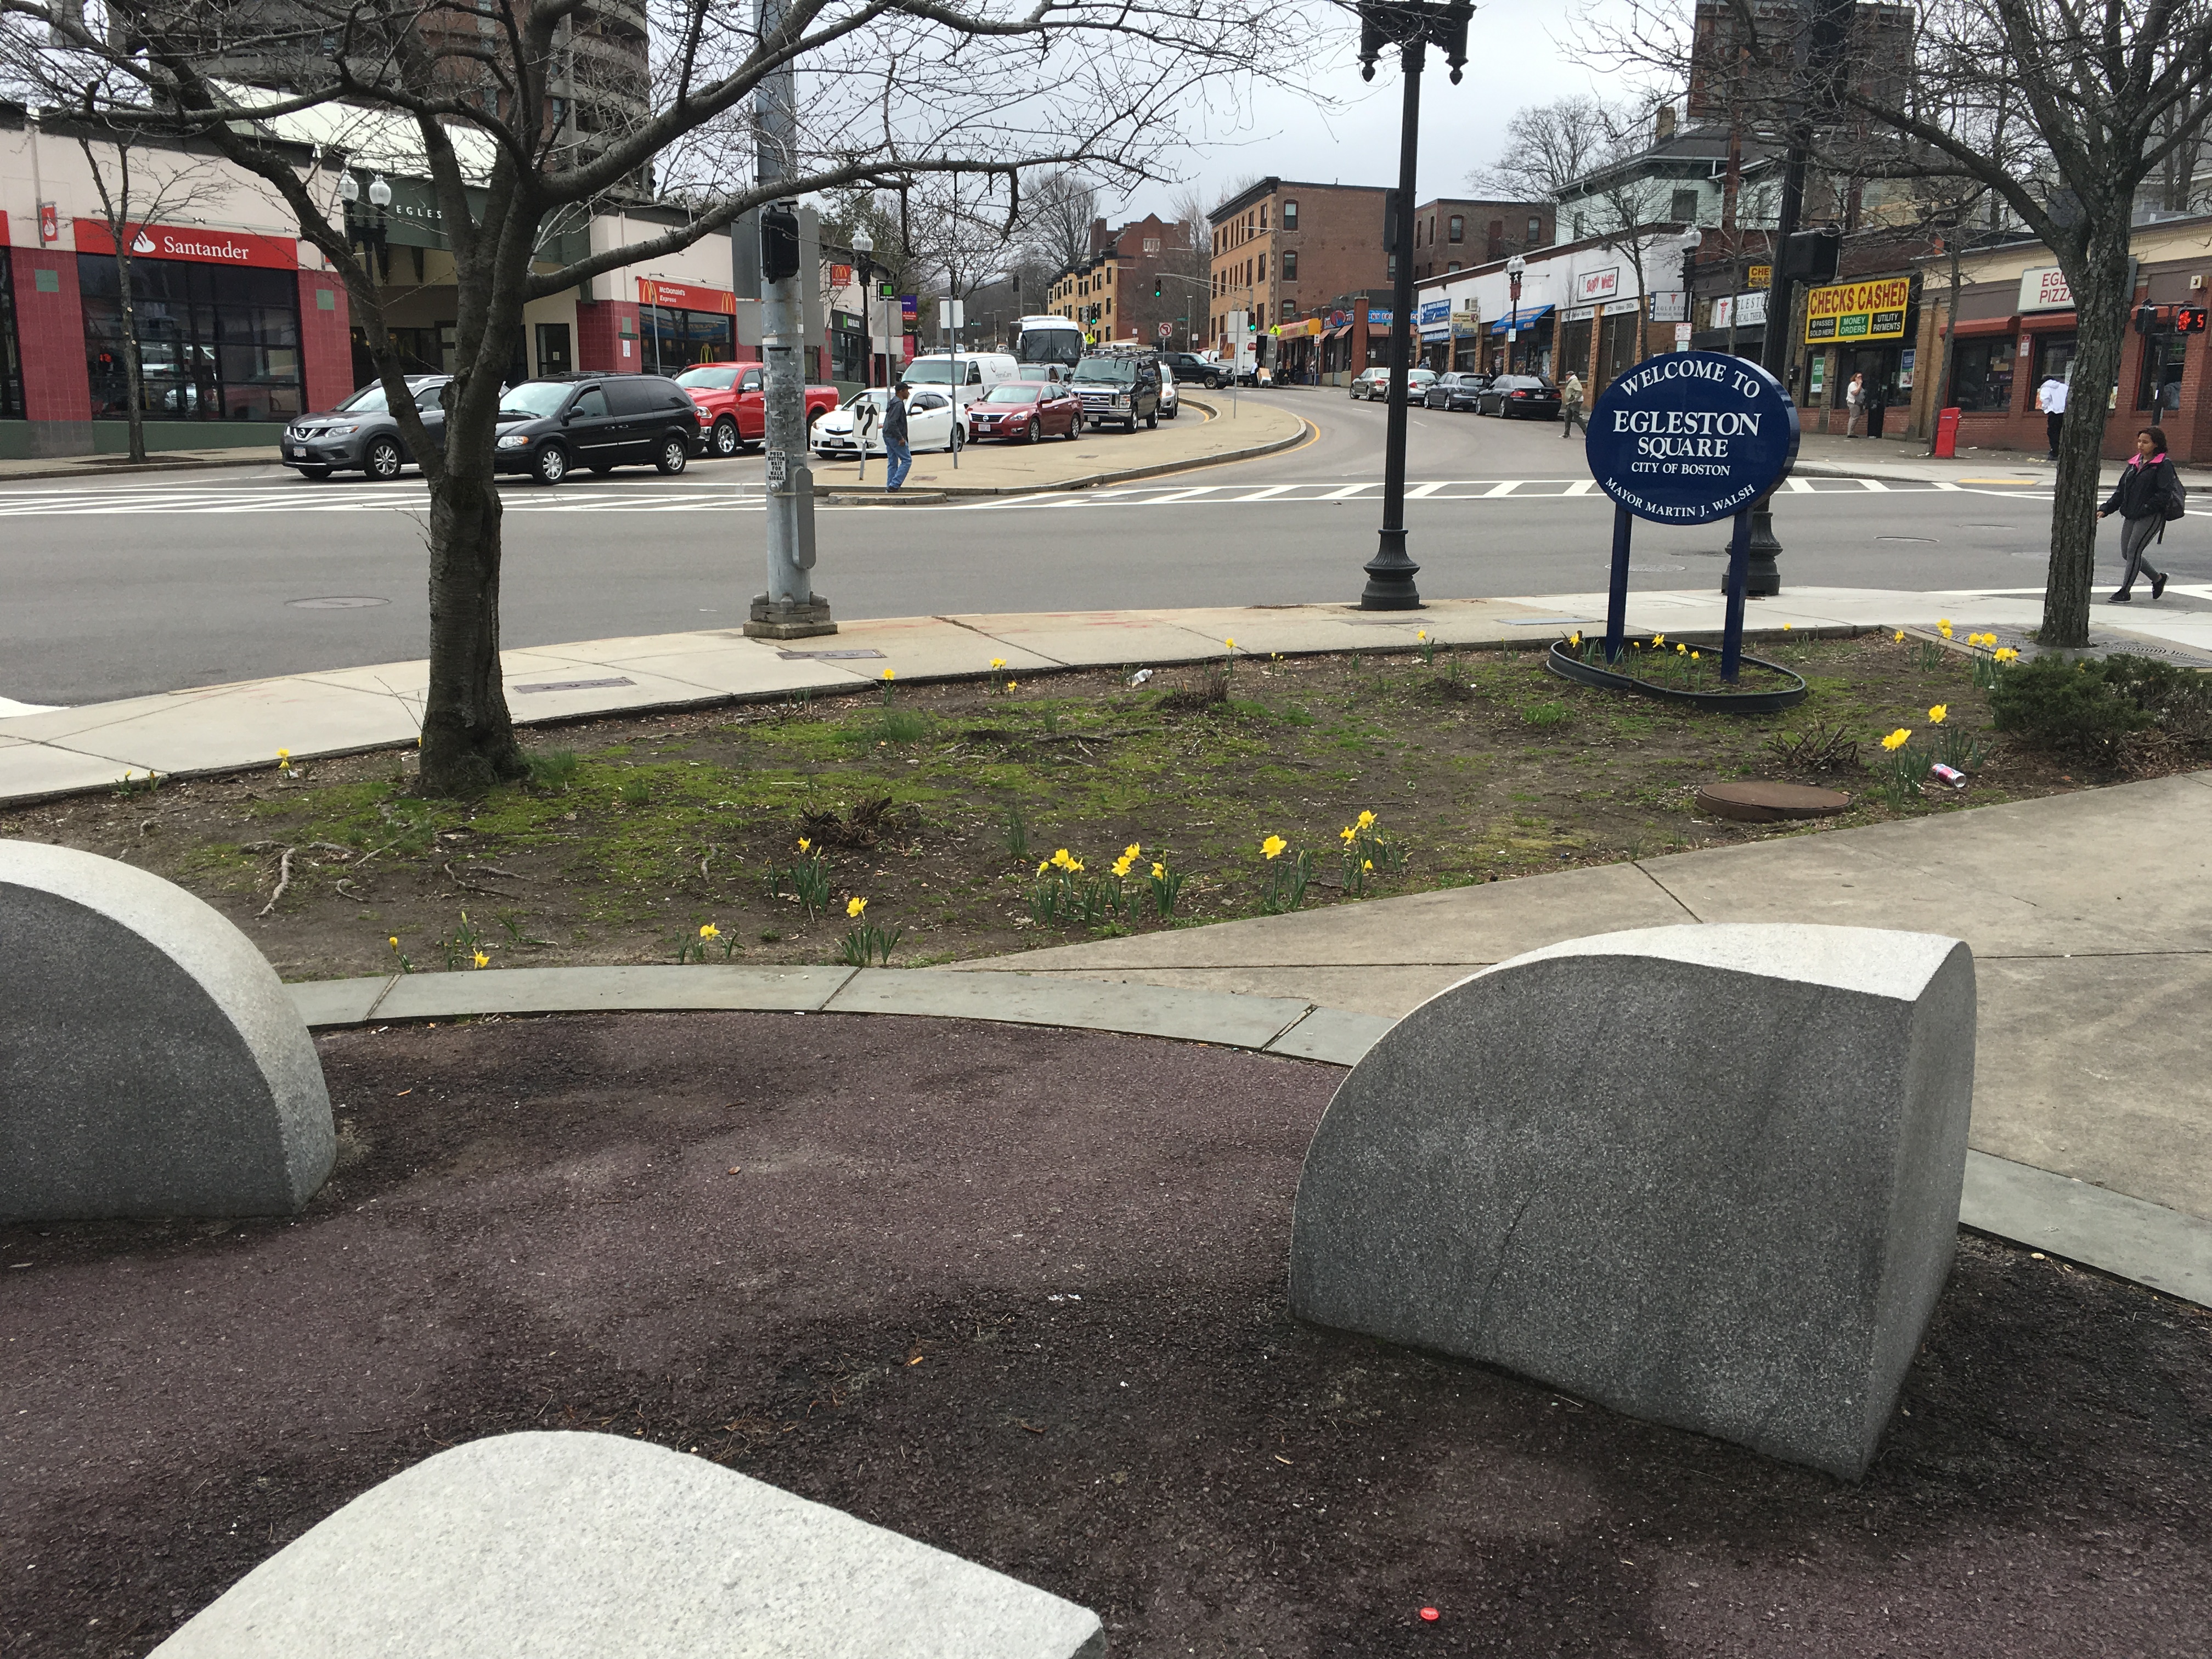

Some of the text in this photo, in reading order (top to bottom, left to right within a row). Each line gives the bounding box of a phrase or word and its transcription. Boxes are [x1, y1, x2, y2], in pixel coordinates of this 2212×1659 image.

[163, 236, 249, 259] Santander
[1751, 268, 1770, 276] CHE
[659, 286, 686, 296] McDonald's
[1810, 281, 1907, 315] CHECKS CASHED
[1733, 296, 1766, 310] GLESTO
[1727, 311, 1766, 324] PSICAL THERA
[1843, 317, 1866, 325] MONEY
[1877, 313, 1899, 322] UTILITY
[2197, 314, 2204, 328] 5
[1840, 325, 1866, 334] ORDERS
[1873, 322, 1901, 331] PAYMENTS
[1620, 360, 1760, 398] WELCOME TO
[1613, 410, 1762, 436] EGLESTON
[1637, 437, 1729, 459] SQUARE
[1631, 461, 1731, 476] CITY OF BOSTON
[1605, 477, 1756, 517] MAYOR MARTIN J. WALSH
